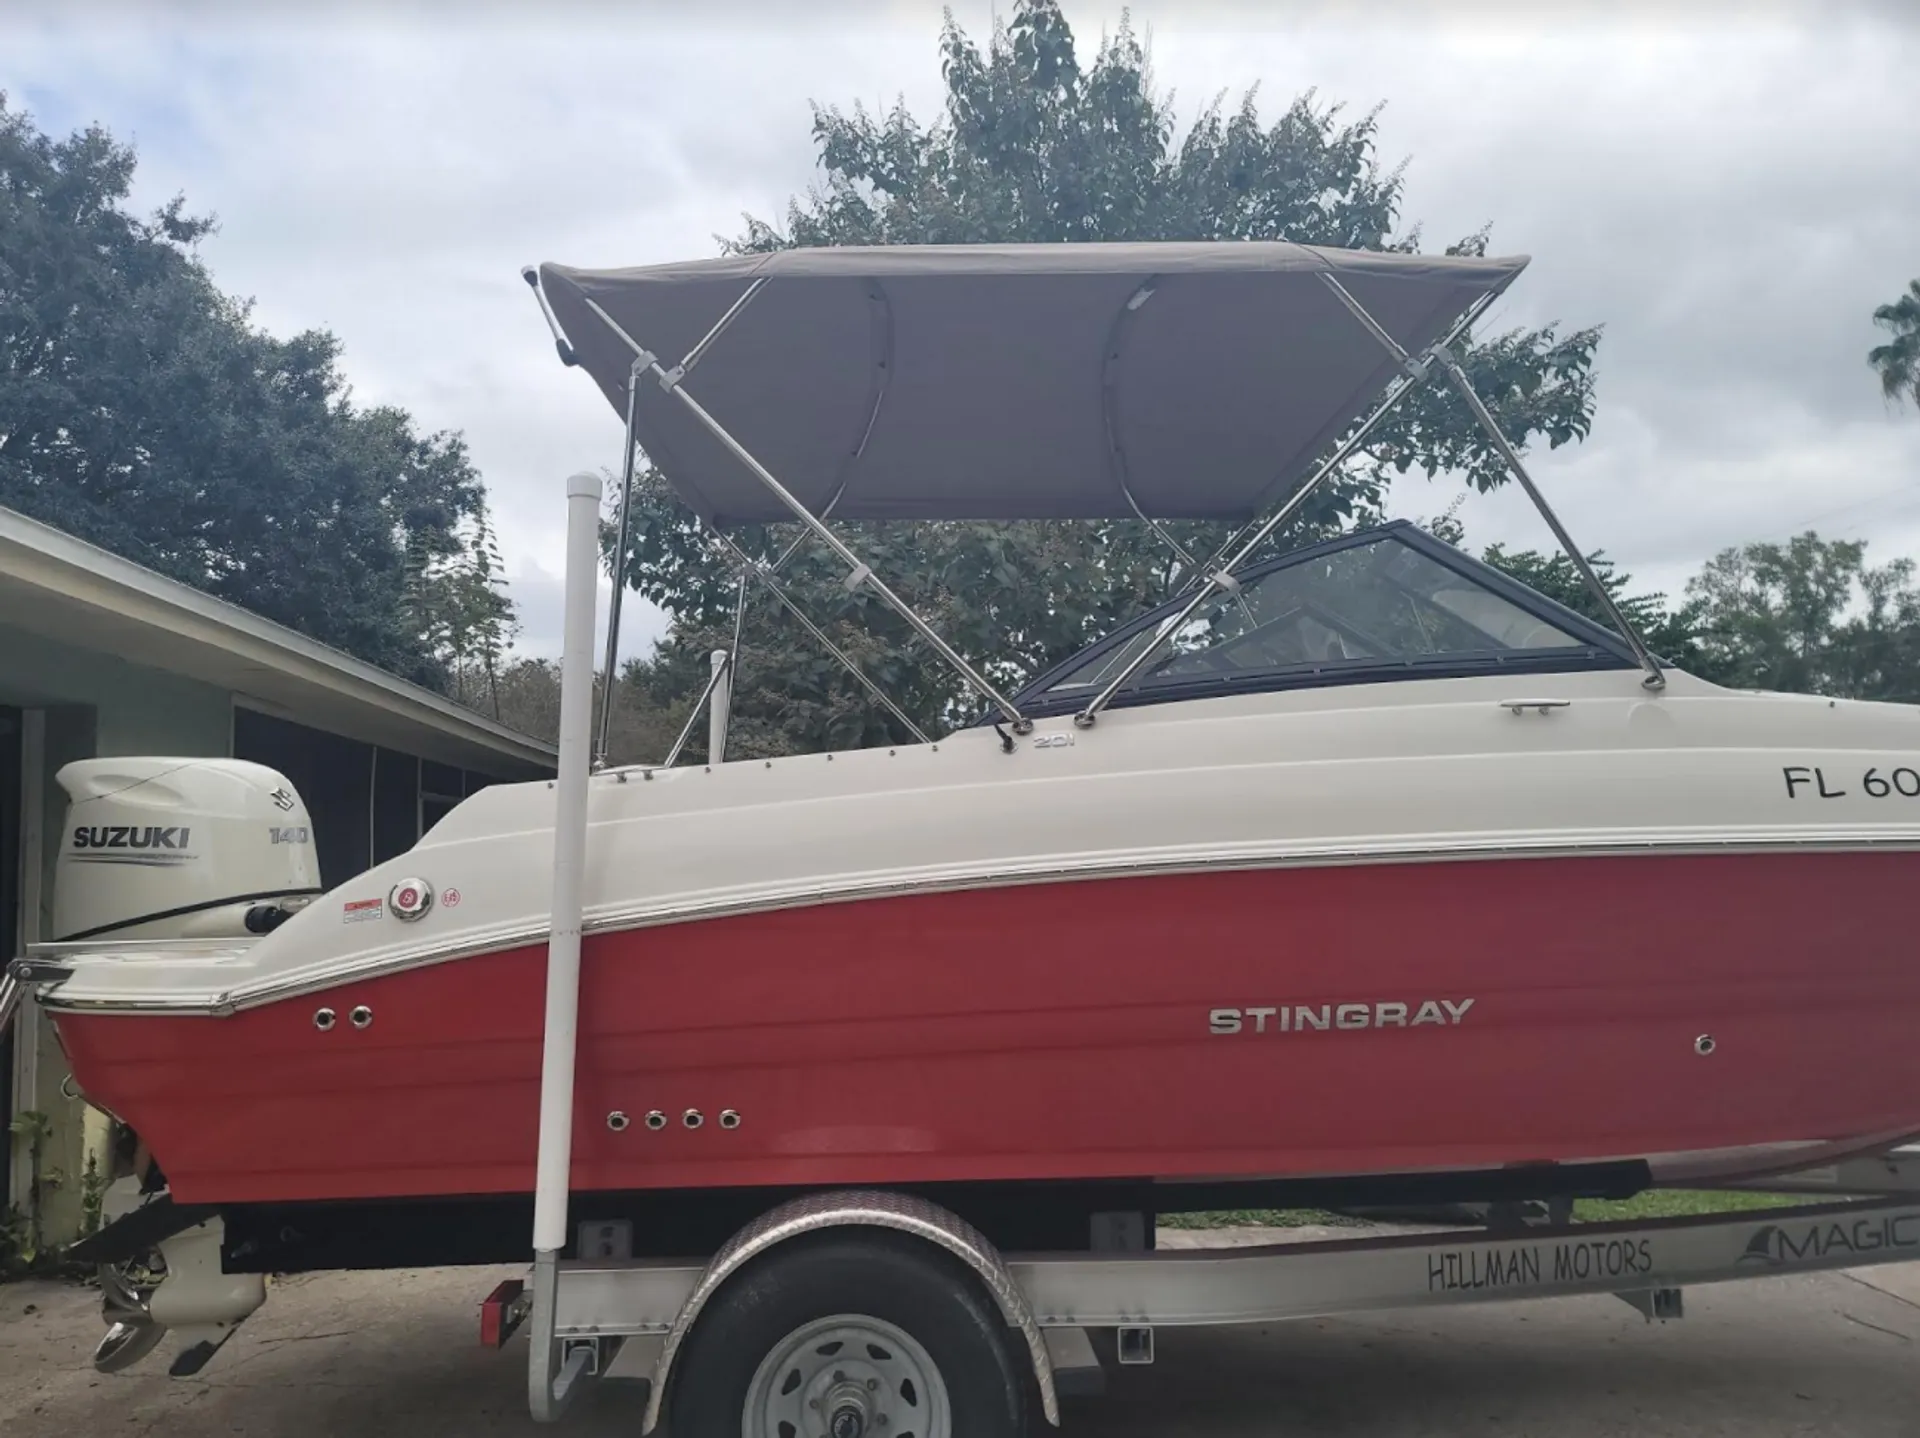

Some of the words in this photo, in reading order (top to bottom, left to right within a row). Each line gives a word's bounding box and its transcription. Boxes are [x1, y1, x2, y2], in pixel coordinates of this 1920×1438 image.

[1783, 767, 1846, 798] FL
[1863, 767, 1920, 798] 60
[73, 826, 190, 848] SUZUKI
[269, 827, 308, 844] 140
[1209, 998, 1475, 1034] STINGRAY
[1777, 1213, 1920, 1259] MAGIC
[1428, 1246, 1540, 1291] HILLMAN
[1554, 1239, 1652, 1281] MOTORS
